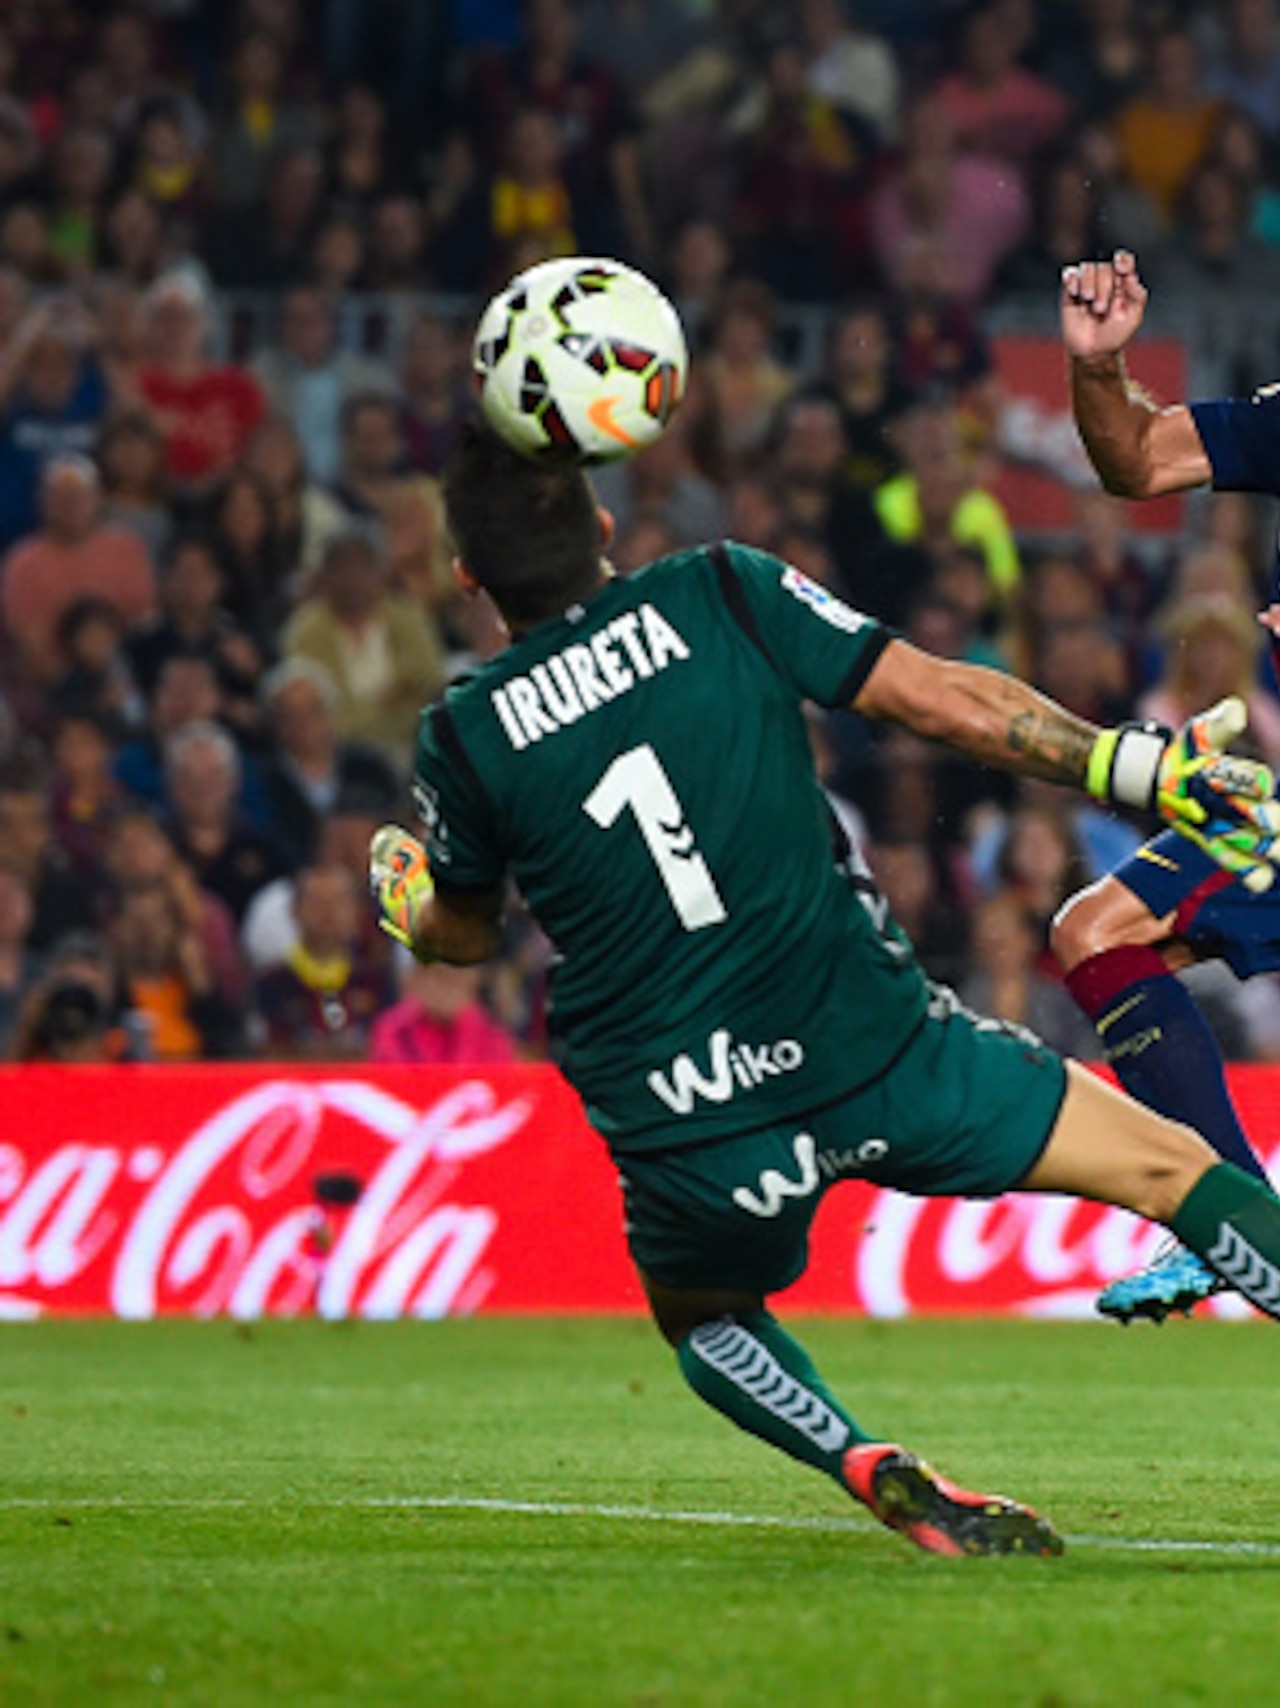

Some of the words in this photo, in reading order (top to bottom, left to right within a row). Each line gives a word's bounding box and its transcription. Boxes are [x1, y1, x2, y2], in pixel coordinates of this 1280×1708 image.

[490, 602, 691, 751] IRURETA
[581, 743, 728, 932] 1
[647, 1027, 804, 1115] Wiko
